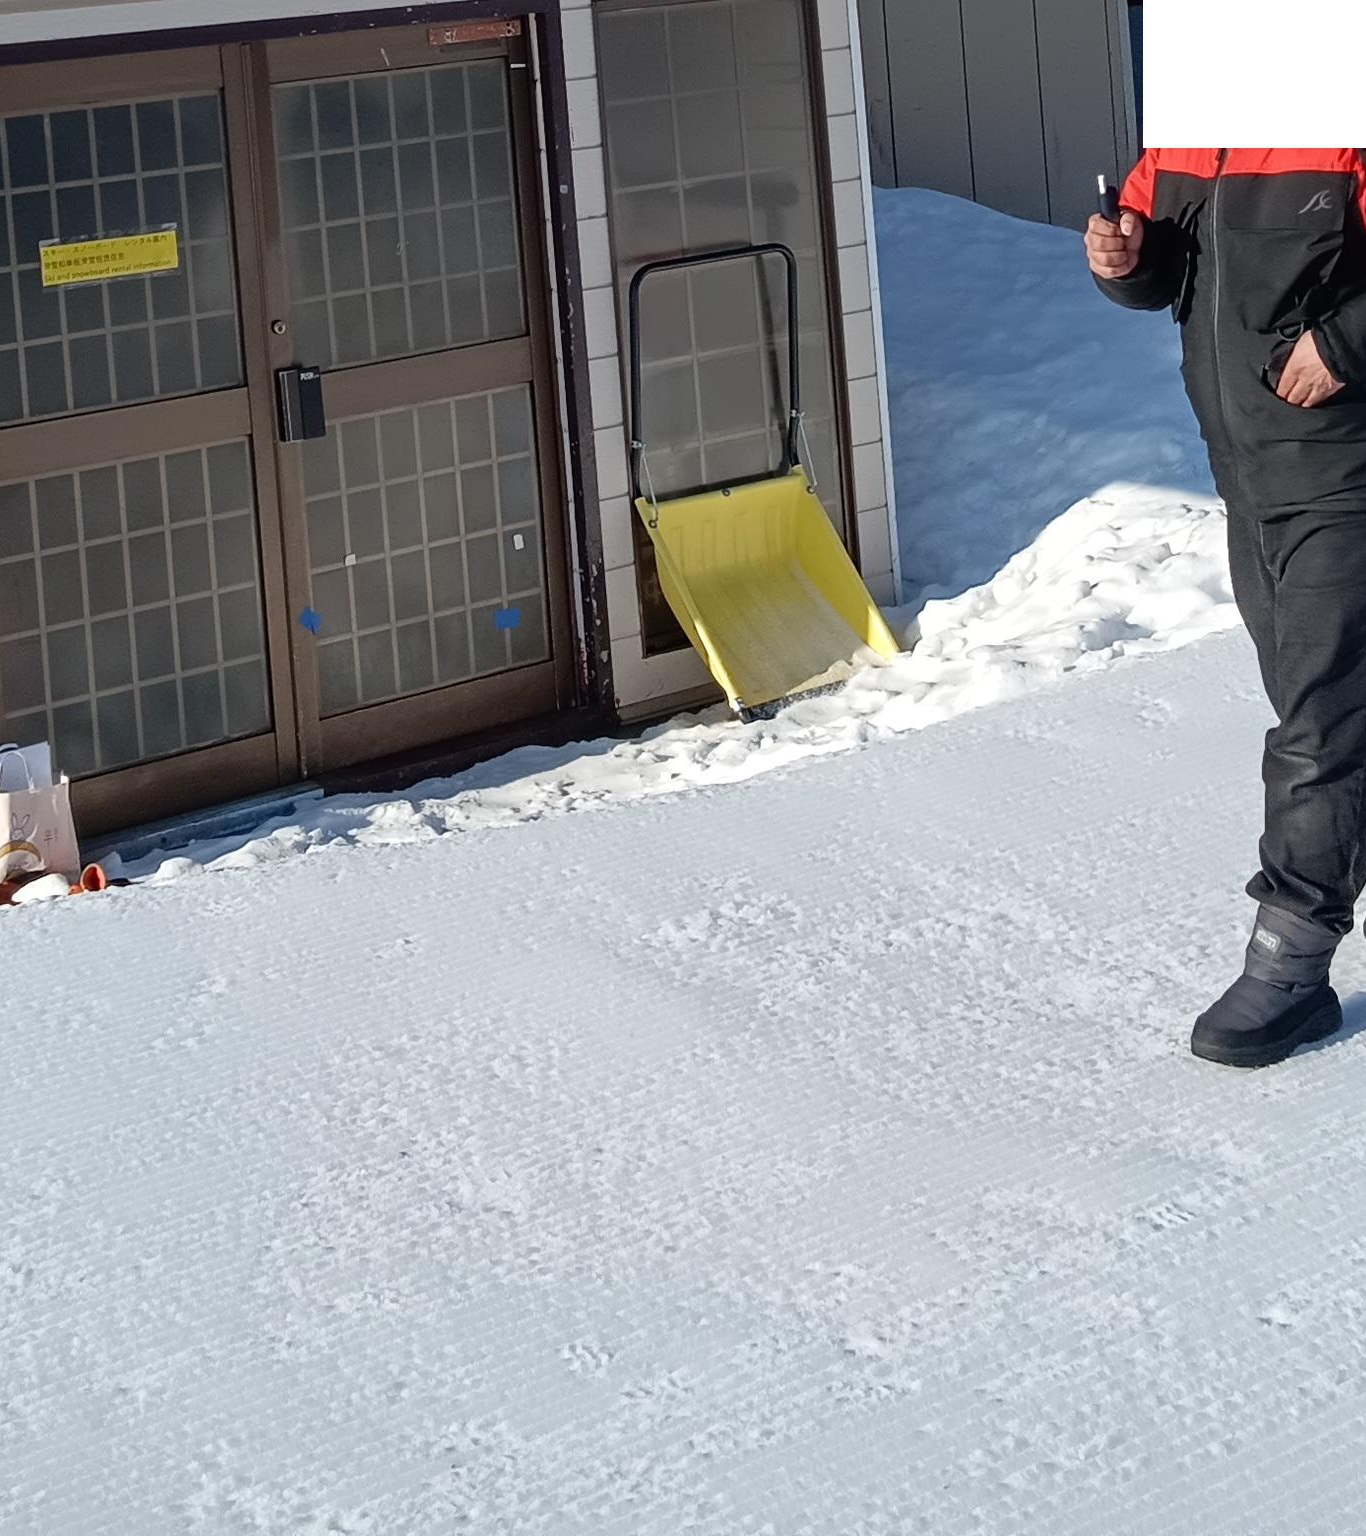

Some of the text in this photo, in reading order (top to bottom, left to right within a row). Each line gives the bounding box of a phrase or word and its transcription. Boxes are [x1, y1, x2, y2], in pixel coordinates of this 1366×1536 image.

[57, 272, 71, 281] and
[72, 266, 110, 279] snowboard
[111, 263, 132, 273] rental
[133, 259, 172, 271] information
